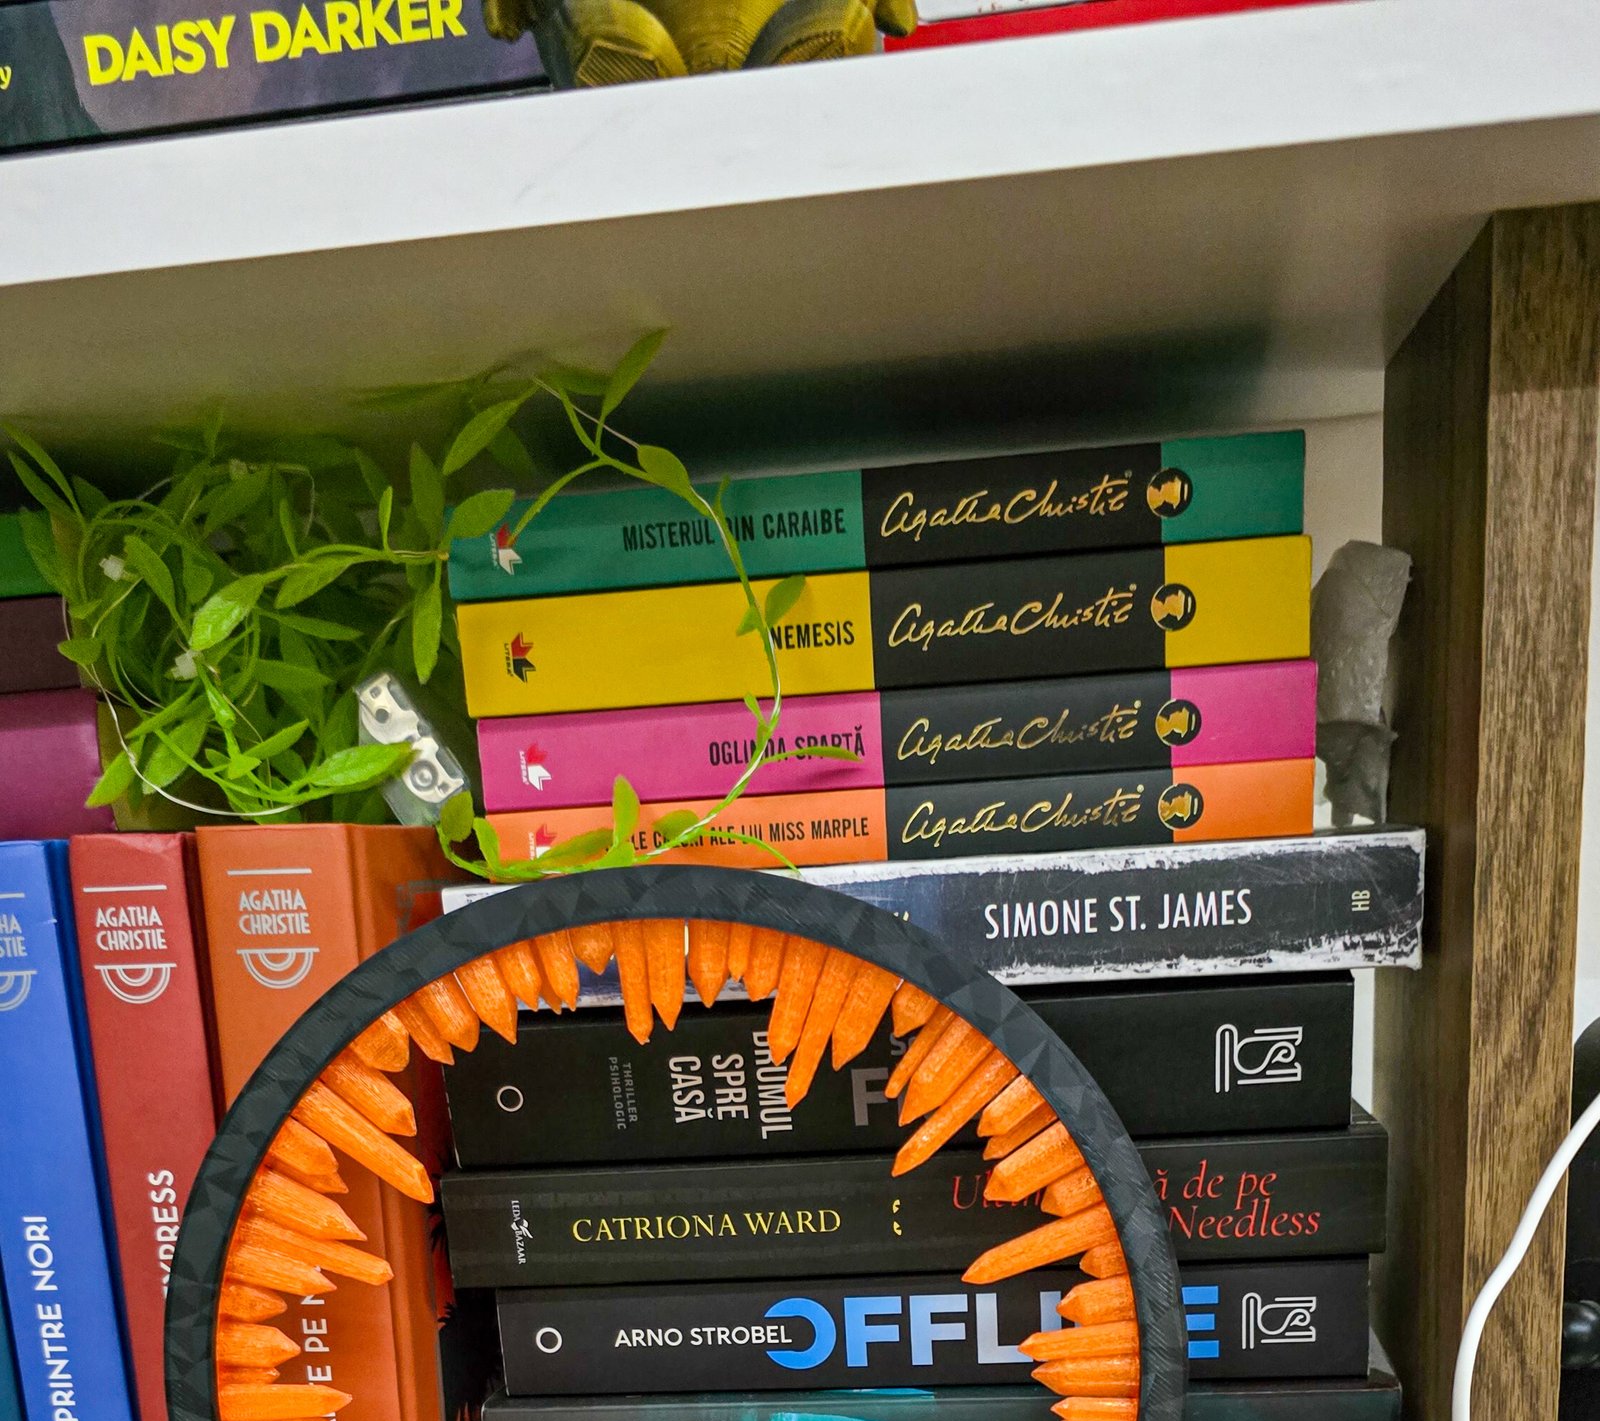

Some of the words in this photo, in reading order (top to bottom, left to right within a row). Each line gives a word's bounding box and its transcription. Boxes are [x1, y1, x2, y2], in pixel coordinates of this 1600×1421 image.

[84, 16, 235, 87] DAISY
[252, 0, 468, 65] DARKER
[622, 518, 715, 552] MISTERUL
[763, 508, 846, 539] CARAIBE
[880, 490, 1002, 541] Agatha
[1003, 473, 1129, 523] Christie
[770, 621, 855, 650] NEMESIS
[888, 601, 1007, 652] Agatha
[1010, 587, 1130, 636] Christie
[897, 717, 1013, 765] Agatha
[1016, 705, 1136, 750] Christie
[710, 826, 736, 846] ALE
[769, 822, 805, 842] MISS
[811, 817, 869, 840] MARPLE
[902, 800, 1017, 847] Agatha
[1020, 785, 1141, 833] Christie
[96, 905, 162, 929] AGATHA
[239, 889, 307, 912] AGATHA
[239, 912, 311, 936] CHRISTIE
[985, 899, 1098, 940] SIMONE
[1109, 893, 1147, 932] ST.
[1157, 888, 1253, 929] JAMES
[1351, 888, 1370, 914] HB
[96, 928, 167, 951] CHRISTIE
[608, 1056, 627, 1131] PSIHOLOGIC
[622, 1061, 639, 1124] THRILLER
[668, 1055, 713, 1125] CASĂ
[712, 1053, 750, 1122] SPRE
[1183, 1159, 1224, 1200] de
[1234, 1169, 1278, 1212] pe
[148, 1169, 180, 1300] PRESS
[572, 1214, 736, 1243] CATRIONA
[744, 1209, 842, 1236] WARD
[1169, 1197, 1321, 1240] Needless
[22, 1216, 60, 1292] NORI
[302, 1318, 330, 1353] PE
[614, 1328, 683, 1348] ARNO
[690, 1325, 793, 1346] STROBEL
[764, 1284, 1220, 1370] OFFLIE
